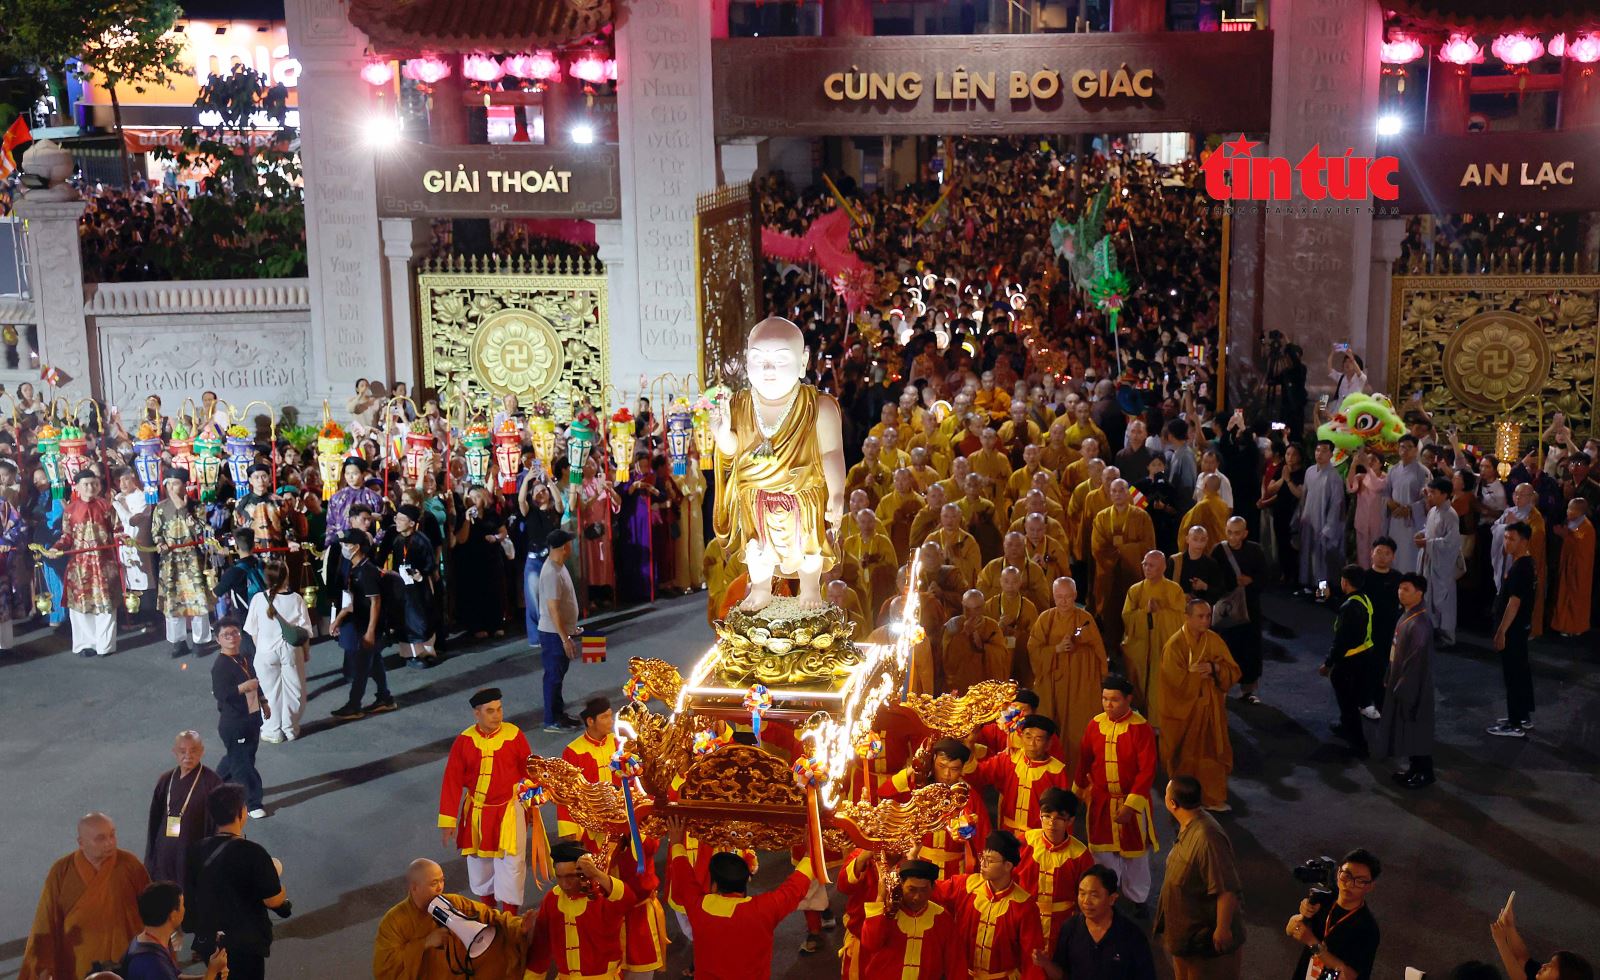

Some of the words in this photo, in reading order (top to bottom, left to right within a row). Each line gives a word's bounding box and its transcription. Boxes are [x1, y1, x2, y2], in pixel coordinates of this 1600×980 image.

[824, 65, 923, 100] CÙNG
[935, 65, 996, 100] LÊN
[1009, 63, 1060, 99] BỜ
[1071, 62, 1153, 99] GIÁC
[423, 163, 480, 193] GIẢI
[487, 164, 572, 193] THOÁT
[1460, 163, 1509, 187] AN
[1520, 161, 1575, 191] LẠC
[127, 369, 205, 391] TRANG
[212, 365, 298, 391] NGHIÊM
